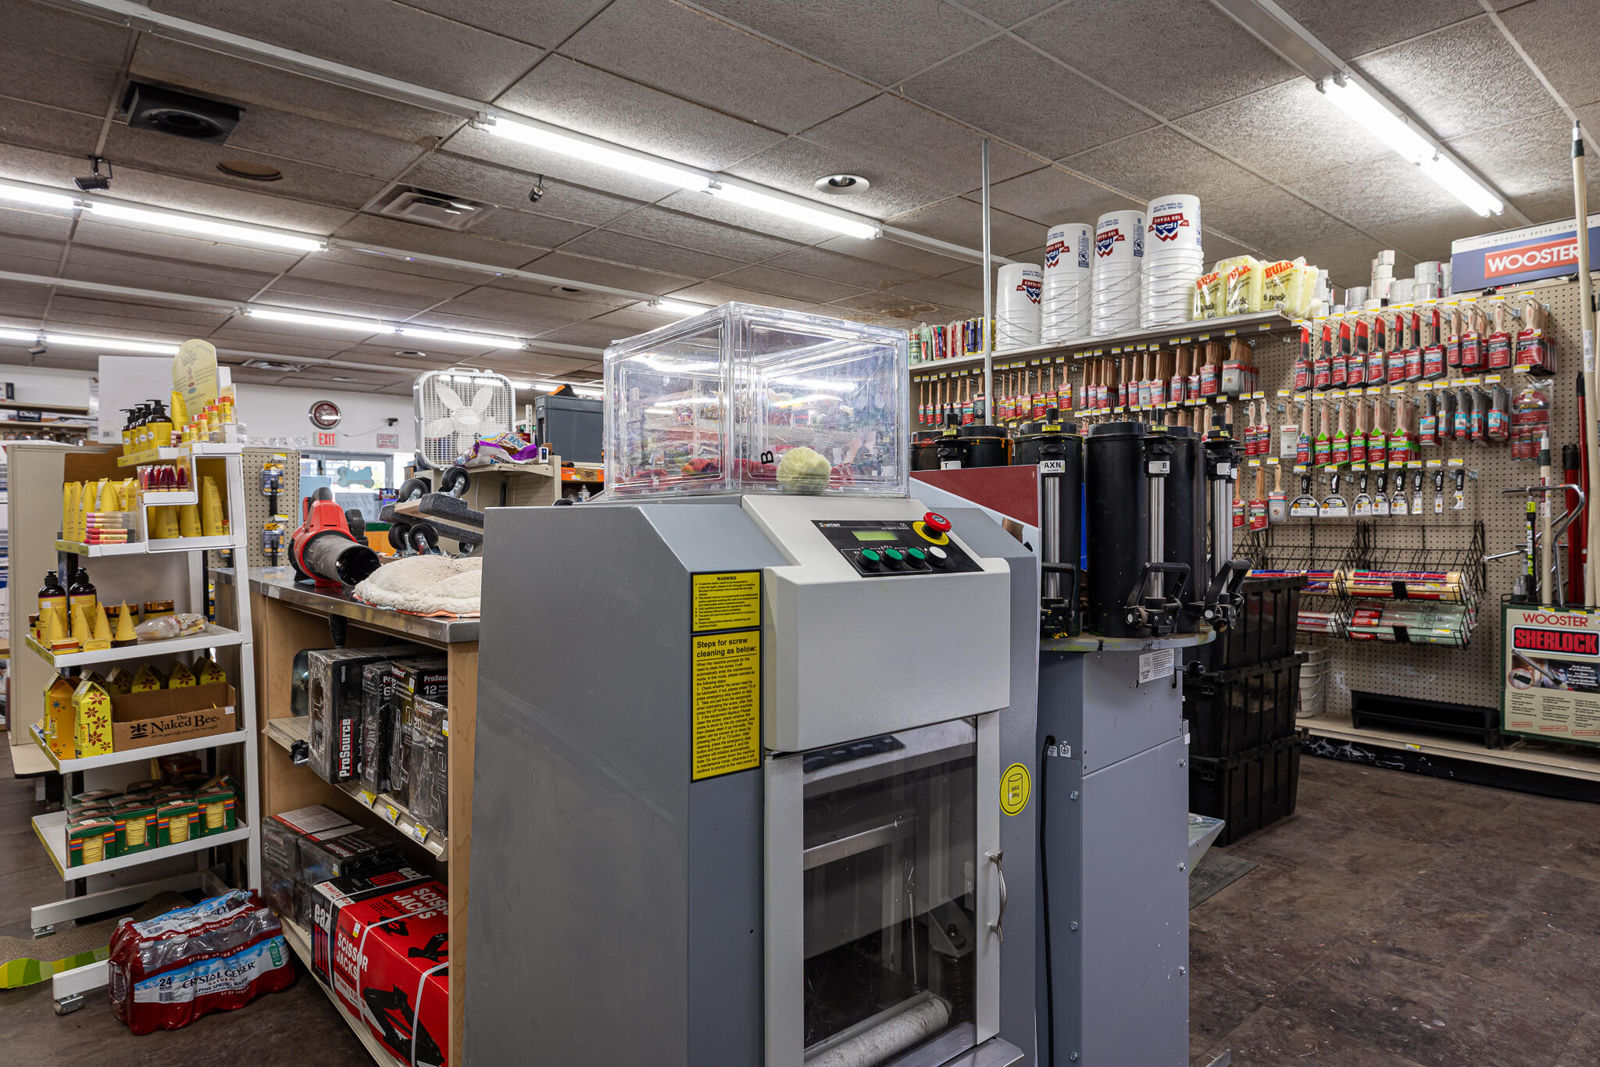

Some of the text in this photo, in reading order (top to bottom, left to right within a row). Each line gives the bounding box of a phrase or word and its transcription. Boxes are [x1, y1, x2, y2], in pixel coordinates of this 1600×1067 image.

[1488, 244, 1580, 272] WOOSTER
[1268, 293, 1286, 302] pack
[318, 432, 336, 446] EXIT
[760, 450, 774, 465] B
[1522, 612, 1588, 628] WOOSTER
[697, 640, 716, 649] Steps
[1515, 628, 1598, 654] SHERLOCK
[697, 649, 725, 658] cleaning
[424, 685, 436, 694] 12
[150, 718, 192, 734] Naked
[194, 714, 218, 727] Bee
[339, 718, 352, 778] ProSource
[224, 962, 256, 978] GEYSER
[336, 953, 359, 978] JACKS
[159, 976, 172, 987] 24
